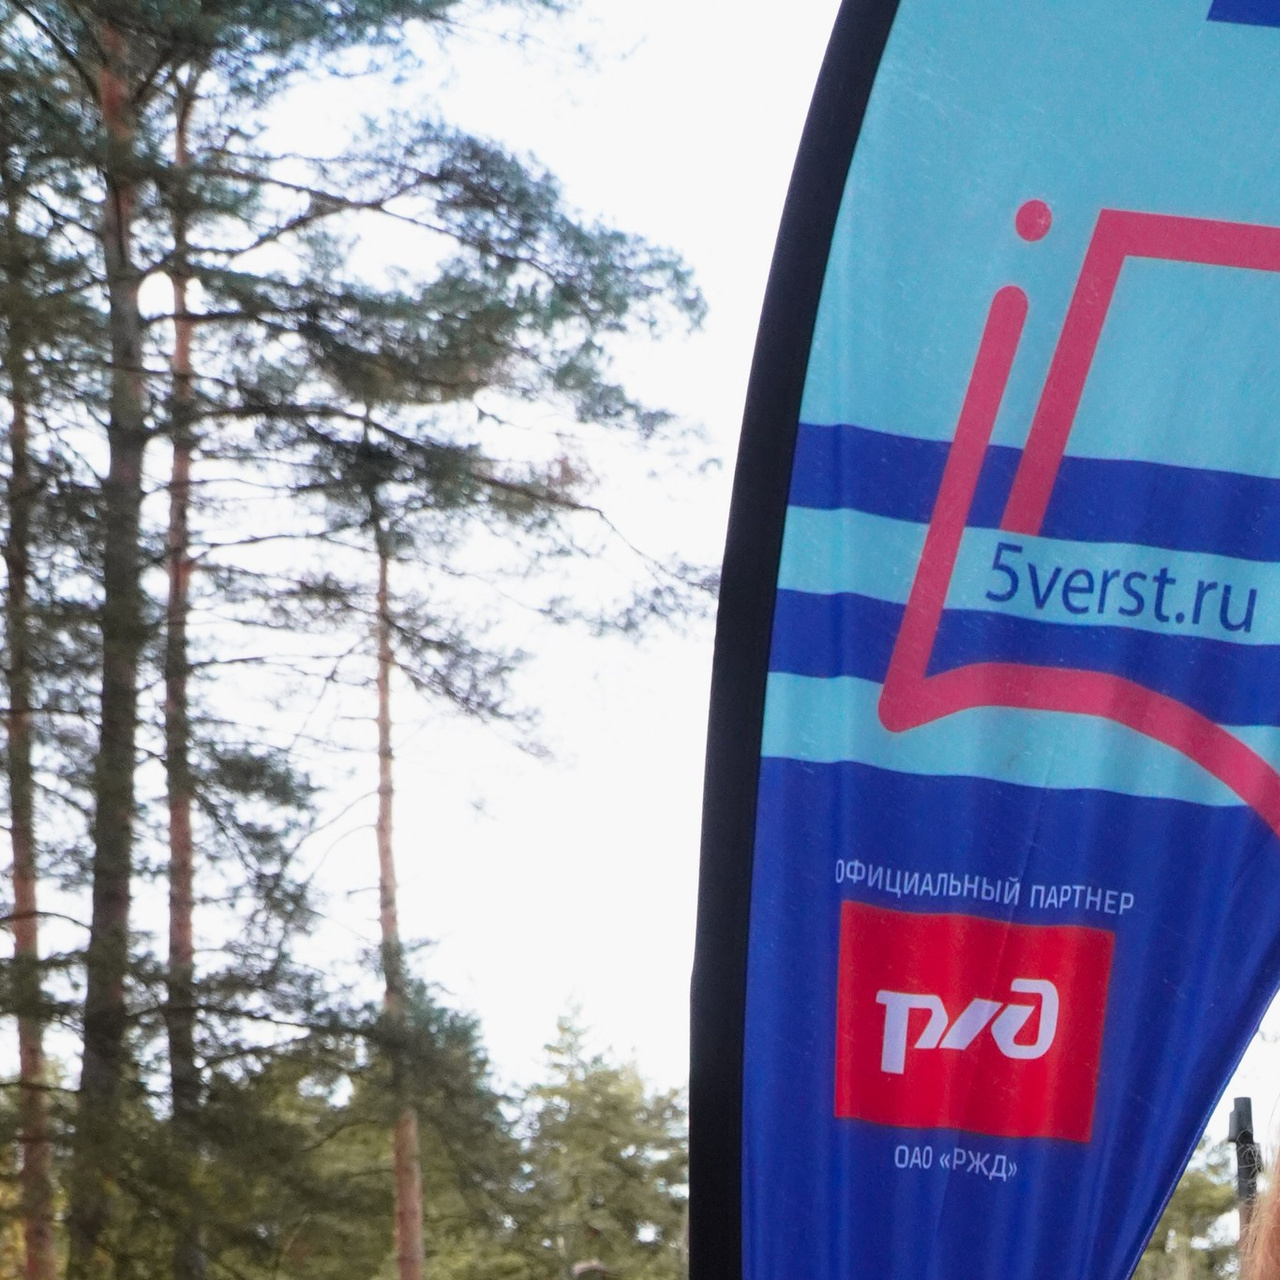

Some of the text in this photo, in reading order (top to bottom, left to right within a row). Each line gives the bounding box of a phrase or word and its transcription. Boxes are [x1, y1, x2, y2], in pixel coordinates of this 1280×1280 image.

[985, 541, 1257, 634] 5verst.ru
[834, 858, 1135, 916] ОФИЦИАЛЬНЫЙ ПАРТНЕР
[893, 1145, 1019, 1182] ОАО «РЖД»
